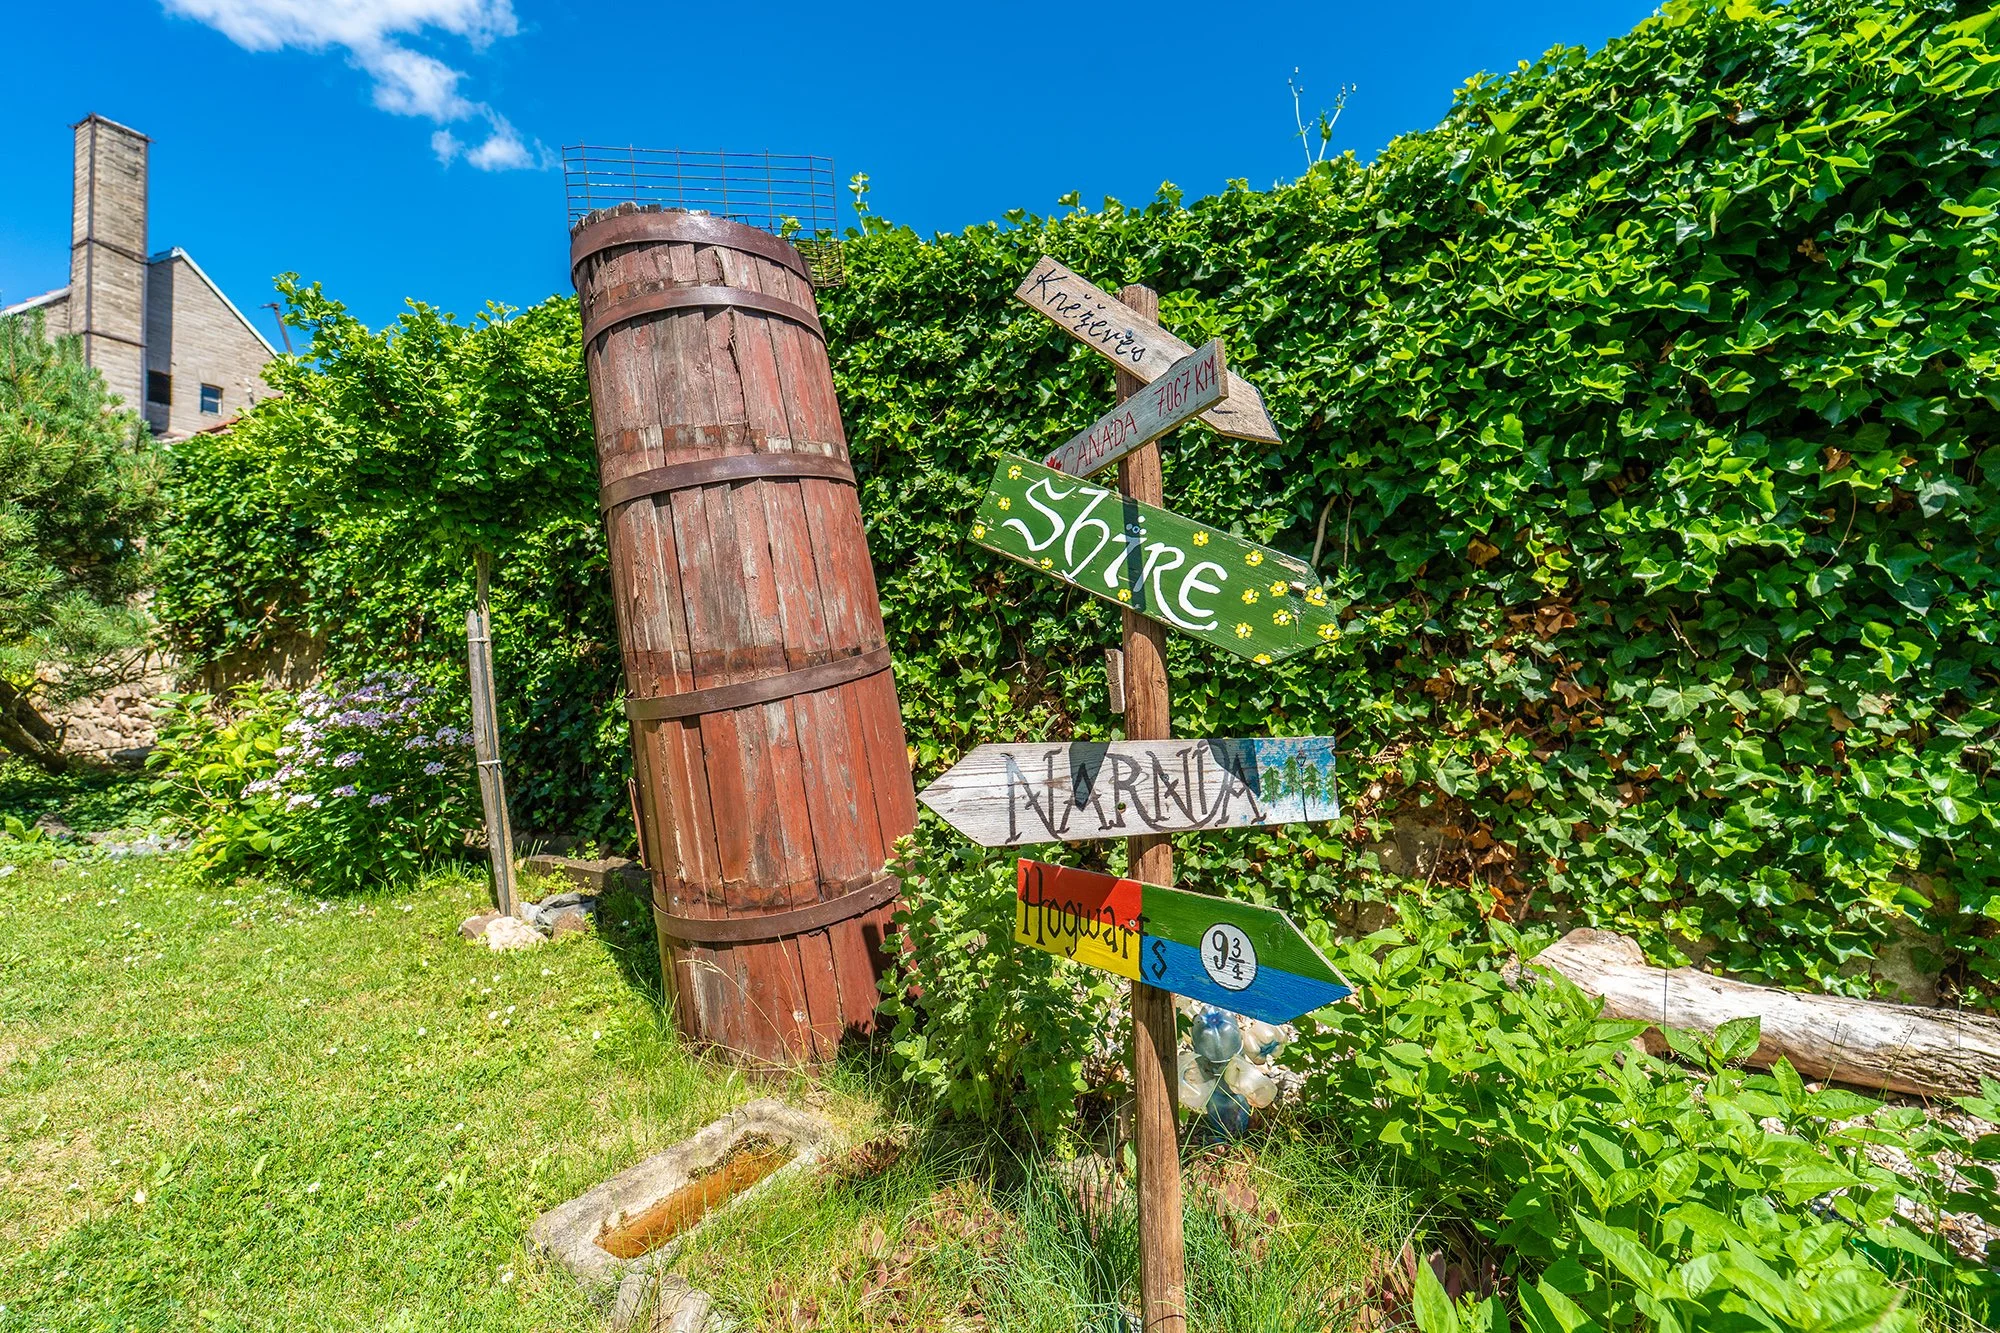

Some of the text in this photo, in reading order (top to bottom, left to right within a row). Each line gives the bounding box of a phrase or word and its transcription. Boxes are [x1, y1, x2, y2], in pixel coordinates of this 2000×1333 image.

[1062, 411, 1138, 475] CANADA
[1194, 355, 1215, 395] KM
[1000, 739, 1267, 844] NARNIA
